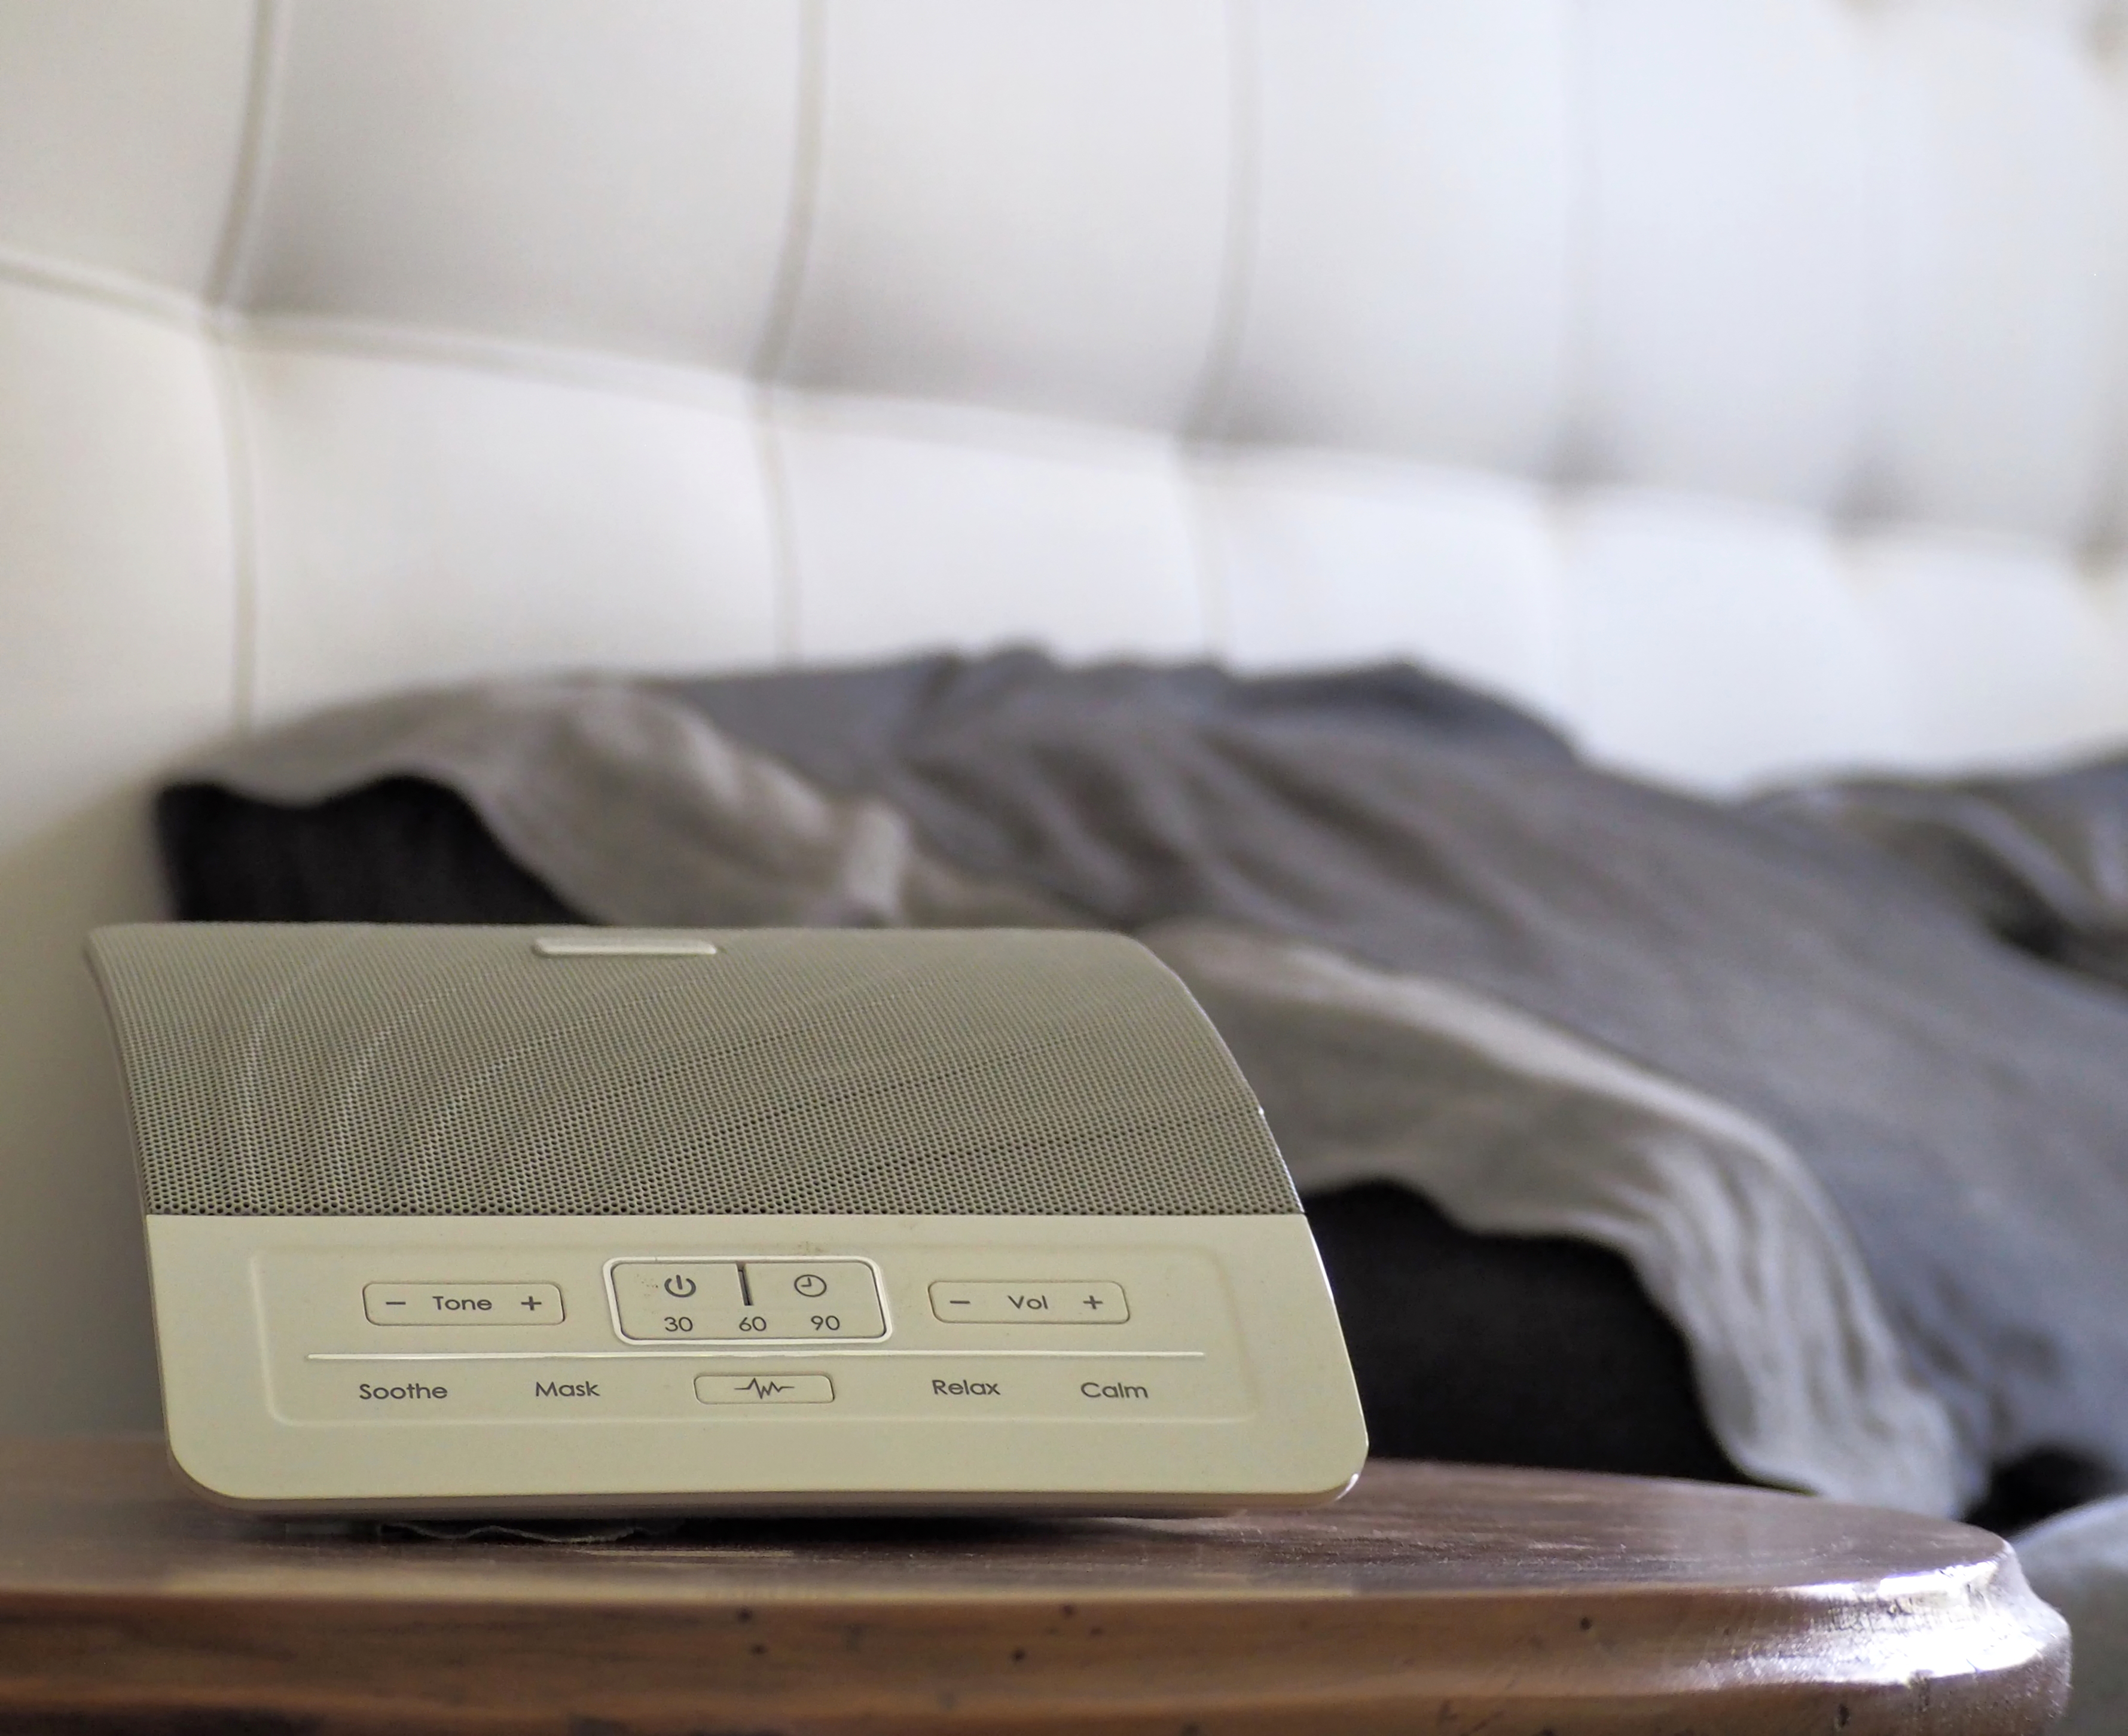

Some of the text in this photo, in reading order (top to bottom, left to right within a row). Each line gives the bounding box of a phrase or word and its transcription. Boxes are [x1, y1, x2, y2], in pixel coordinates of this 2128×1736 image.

[432, 1295, 492, 1311] Tone
[1007, 1295, 1048, 1310] Vol
[664, 1315, 840, 1332] 30 60 90
[359, 1383, 448, 1400] Soothe
[535, 1380, 600, 1397] Mask
[932, 1379, 1001, 1395] Relax
[1080, 1382, 1149, 1398] Calm
